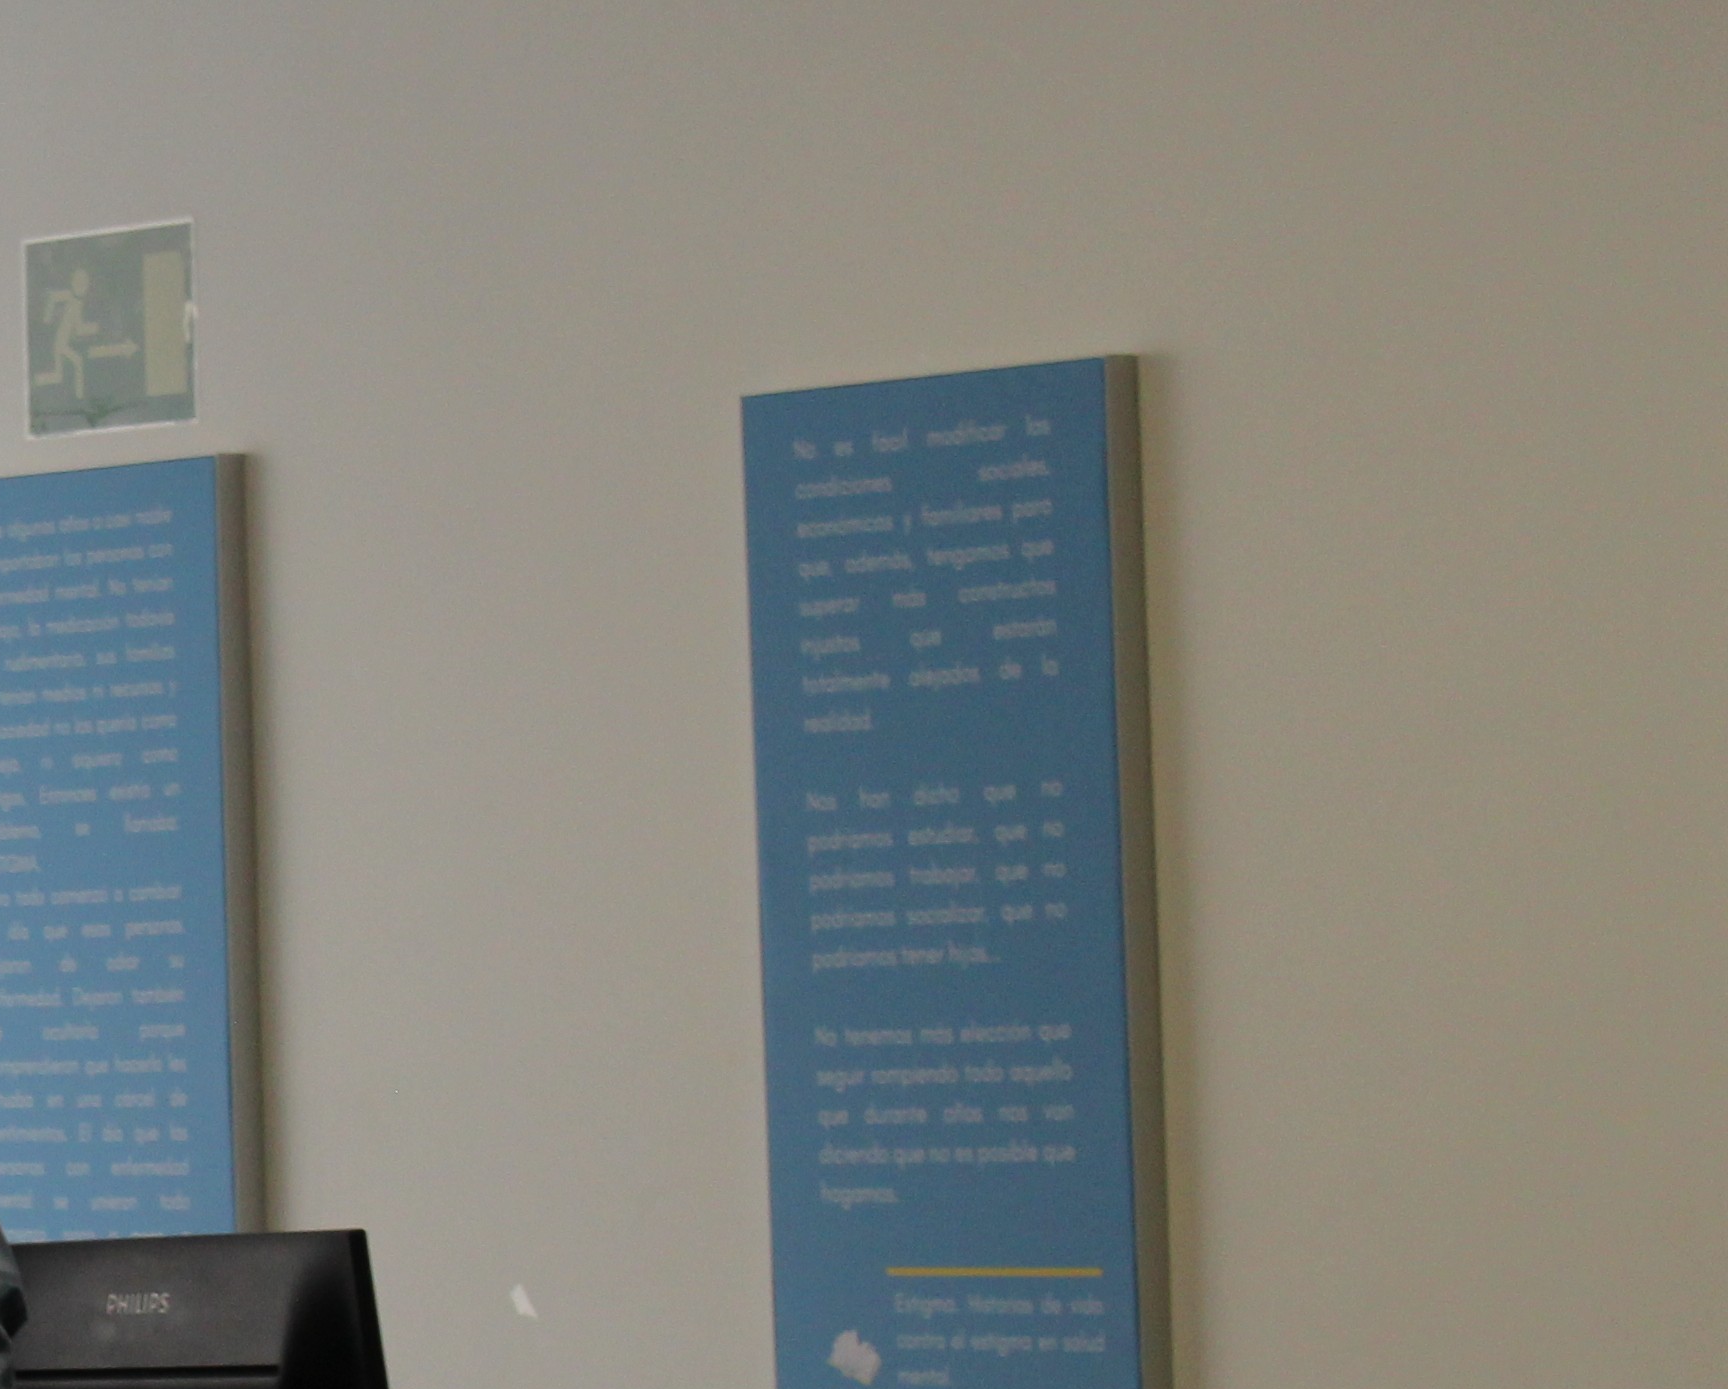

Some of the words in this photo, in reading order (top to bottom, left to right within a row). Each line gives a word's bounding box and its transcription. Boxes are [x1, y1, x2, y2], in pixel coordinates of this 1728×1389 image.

[795, 475, 895, 500] condiciones
[793, 515, 895, 539] económicas
[920, 500, 1004, 527] familiares
[106, 1293, 171, 1314] PHILIPS
